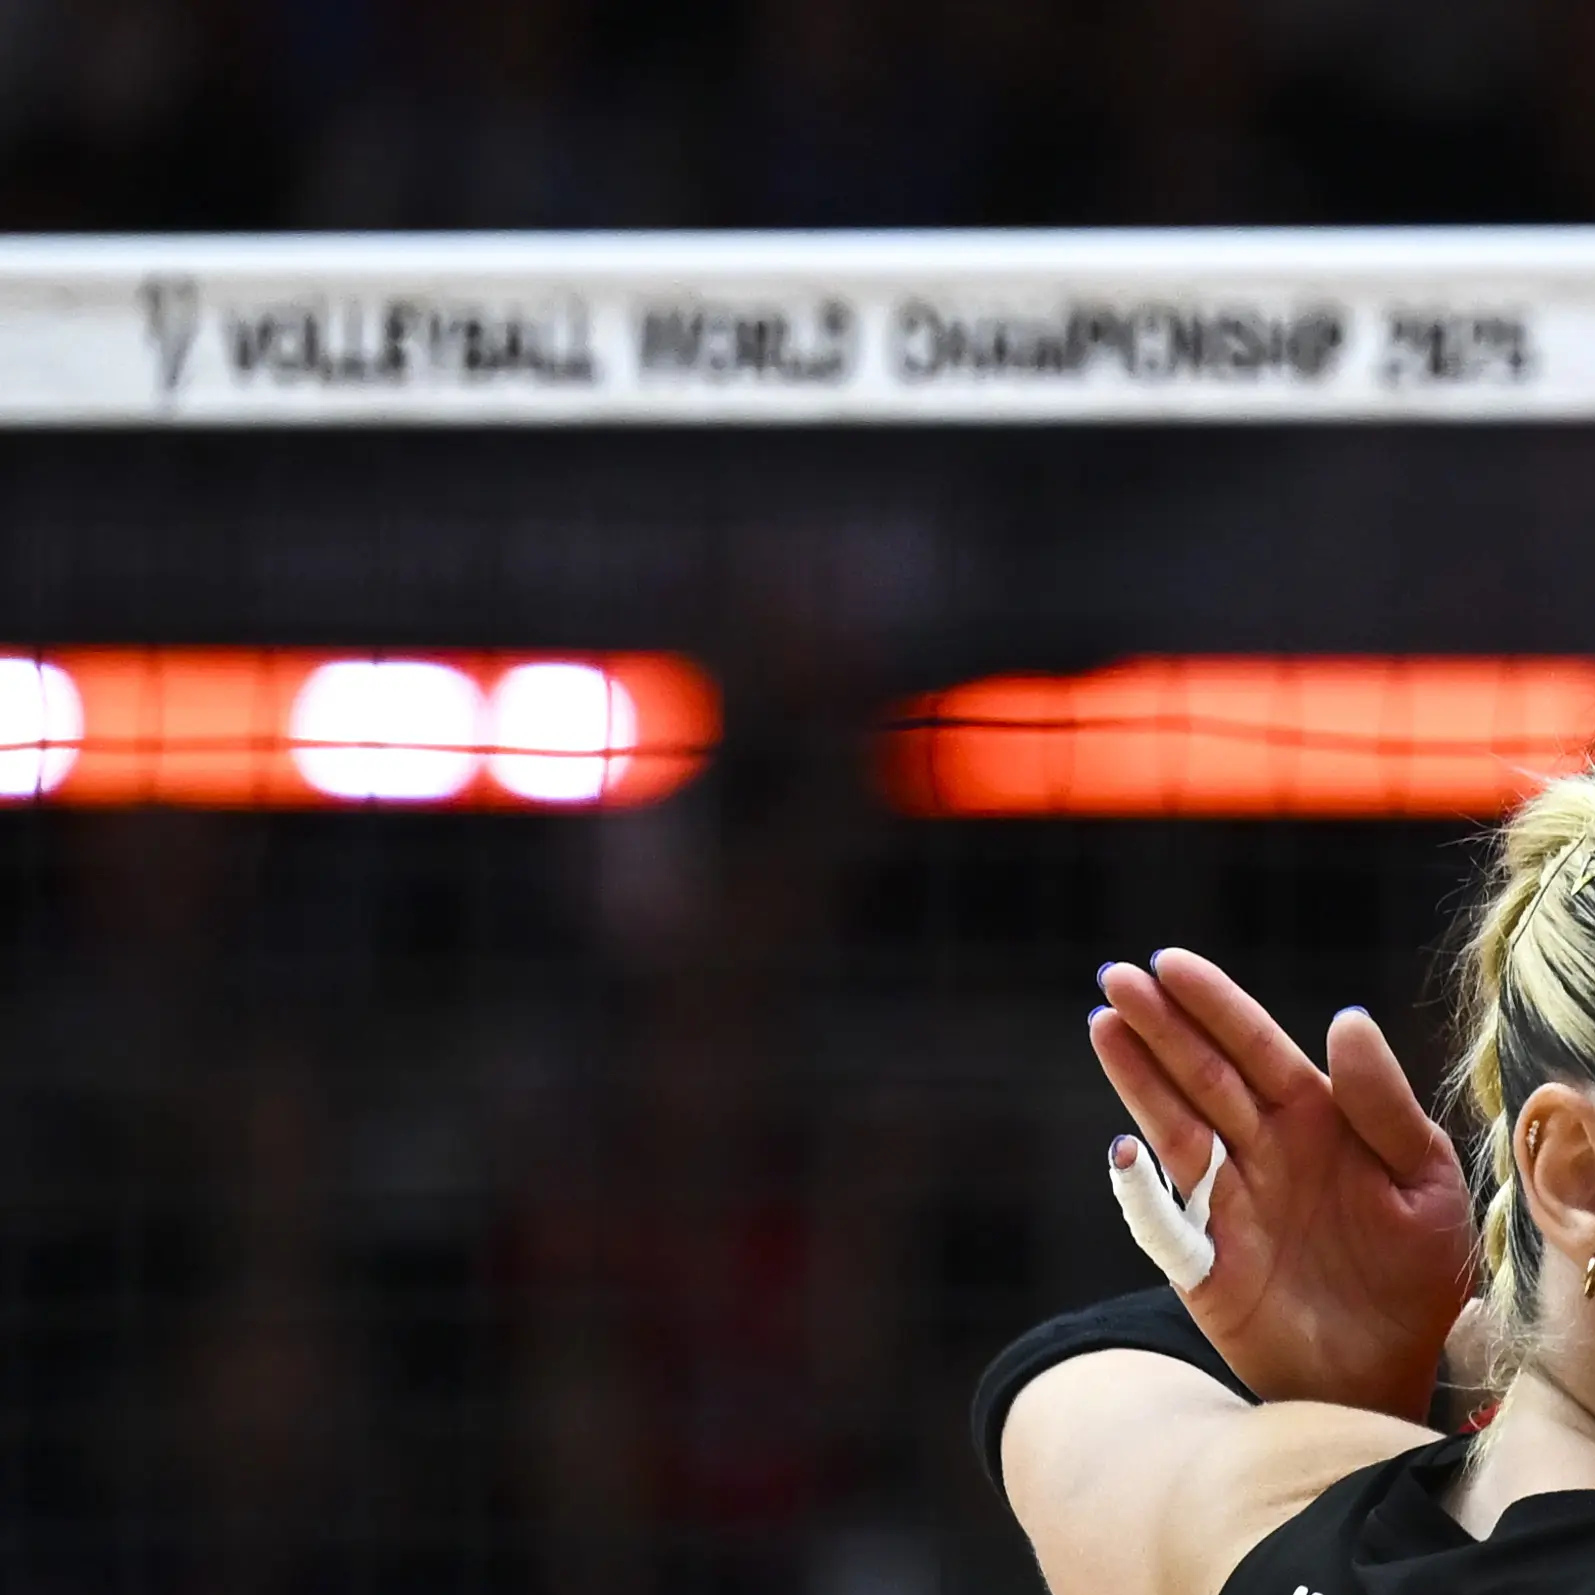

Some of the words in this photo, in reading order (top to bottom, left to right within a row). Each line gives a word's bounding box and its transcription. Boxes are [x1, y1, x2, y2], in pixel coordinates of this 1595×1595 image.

[228, 306, 594, 382] VOLLEYBALL
[640, 304, 848, 382] WORLD
[898, 304, 1342, 380] CHAMPIONSHIP
